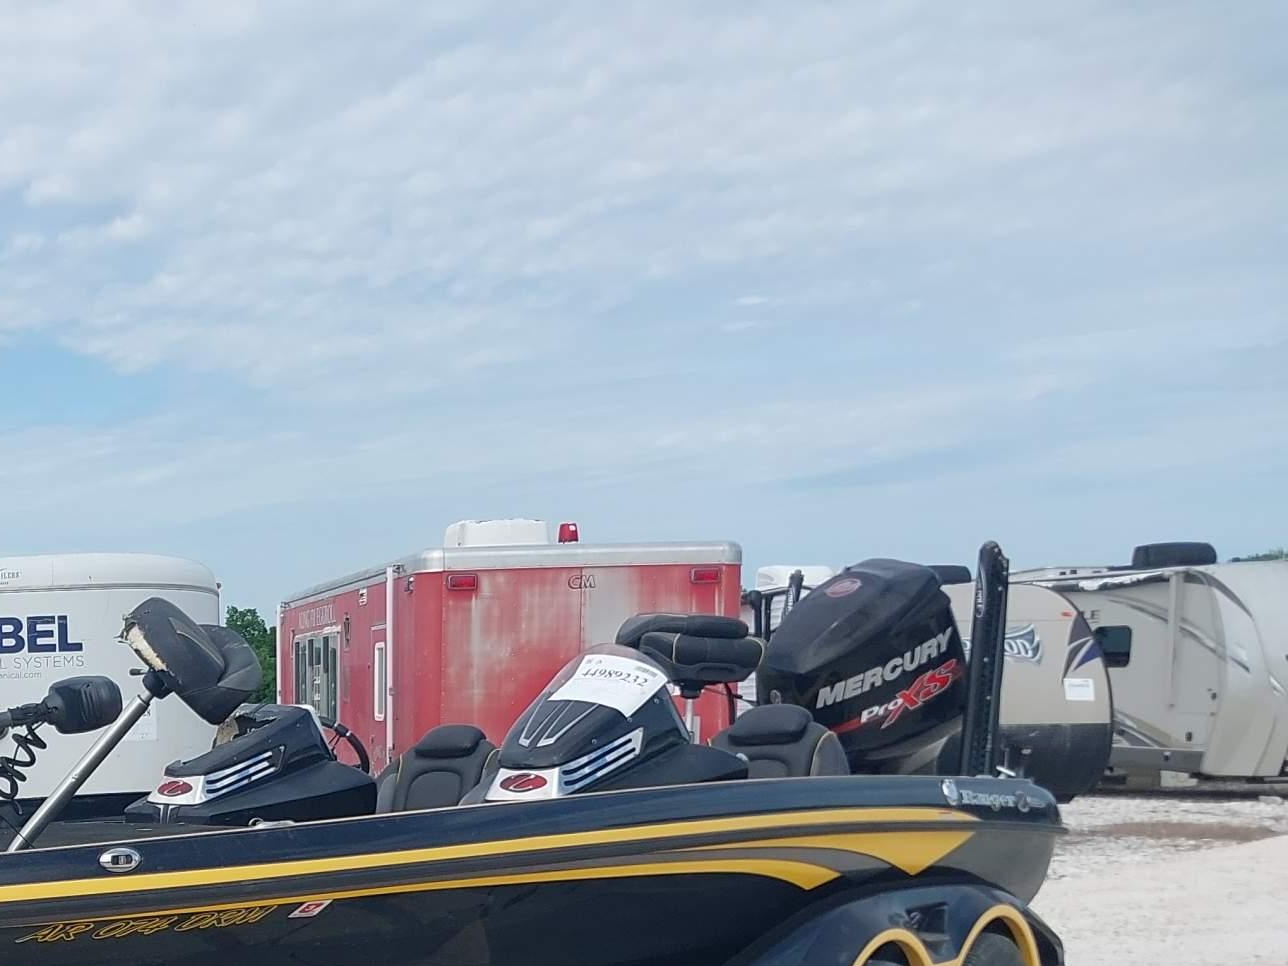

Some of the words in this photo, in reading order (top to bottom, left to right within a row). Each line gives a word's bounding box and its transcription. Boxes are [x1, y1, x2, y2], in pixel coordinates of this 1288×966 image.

[13, 655, 85, 670] SYSTEMS
[816, 626, 953, 709] MERCURY
[15, 922, 94, 943] AR
